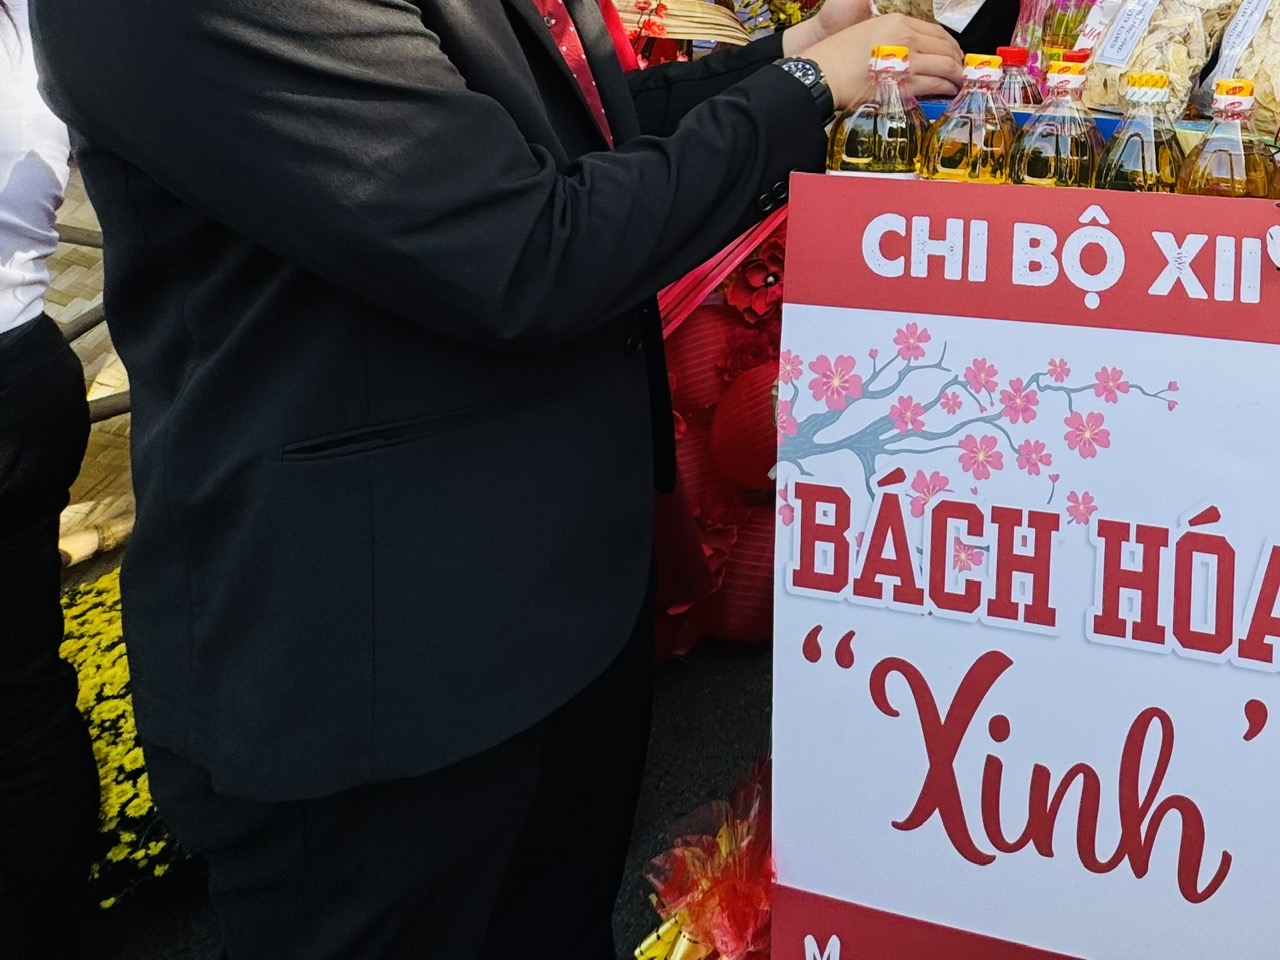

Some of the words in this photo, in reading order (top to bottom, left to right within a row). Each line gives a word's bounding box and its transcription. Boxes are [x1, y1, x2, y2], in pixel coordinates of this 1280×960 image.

[861, 212, 988, 283] CHI
[1011, 204, 1126, 309] BỘ
[1148, 230, 1262, 305] XII
[791, 466, 1058, 629] BÁCH
